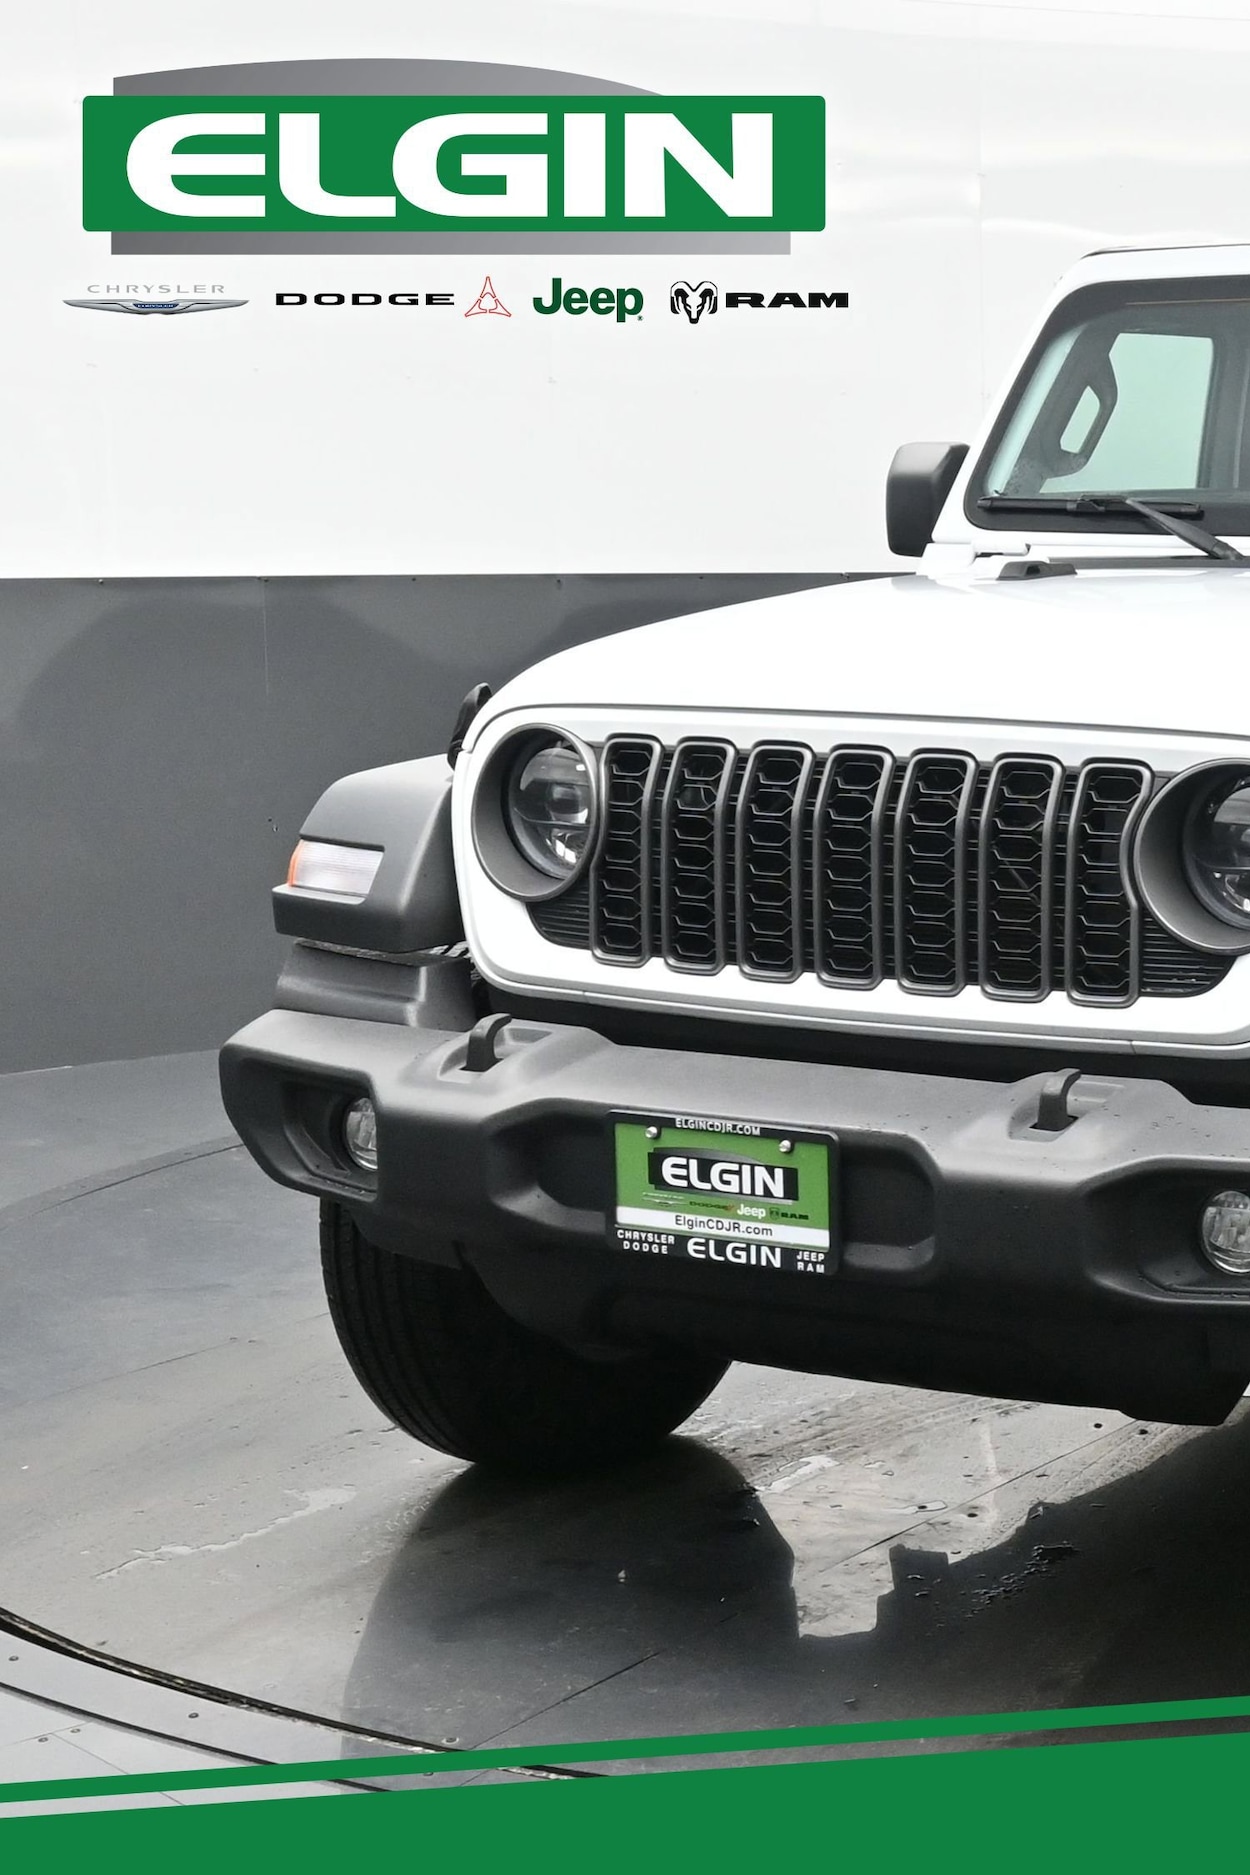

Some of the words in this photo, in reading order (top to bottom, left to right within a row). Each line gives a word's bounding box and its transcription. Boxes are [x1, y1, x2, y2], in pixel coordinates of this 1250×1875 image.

[675, 1118, 761, 1136] ELGINCDJR.COM
[661, 1156, 785, 1198] ELGIN
[737, 1203, 767, 1219] Jeep
[781, 1211, 809, 1221] RAM
[675, 1215, 773, 1237] ElginCDJR.com
[617, 1229, 675, 1245] CHRYSLER
[623, 1241, 668, 1254] DODGE
[687, 1237, 781, 1268] ELGIN
[796, 1251, 825, 1262] JEEP
[797, 1262, 825, 1274] RAM
